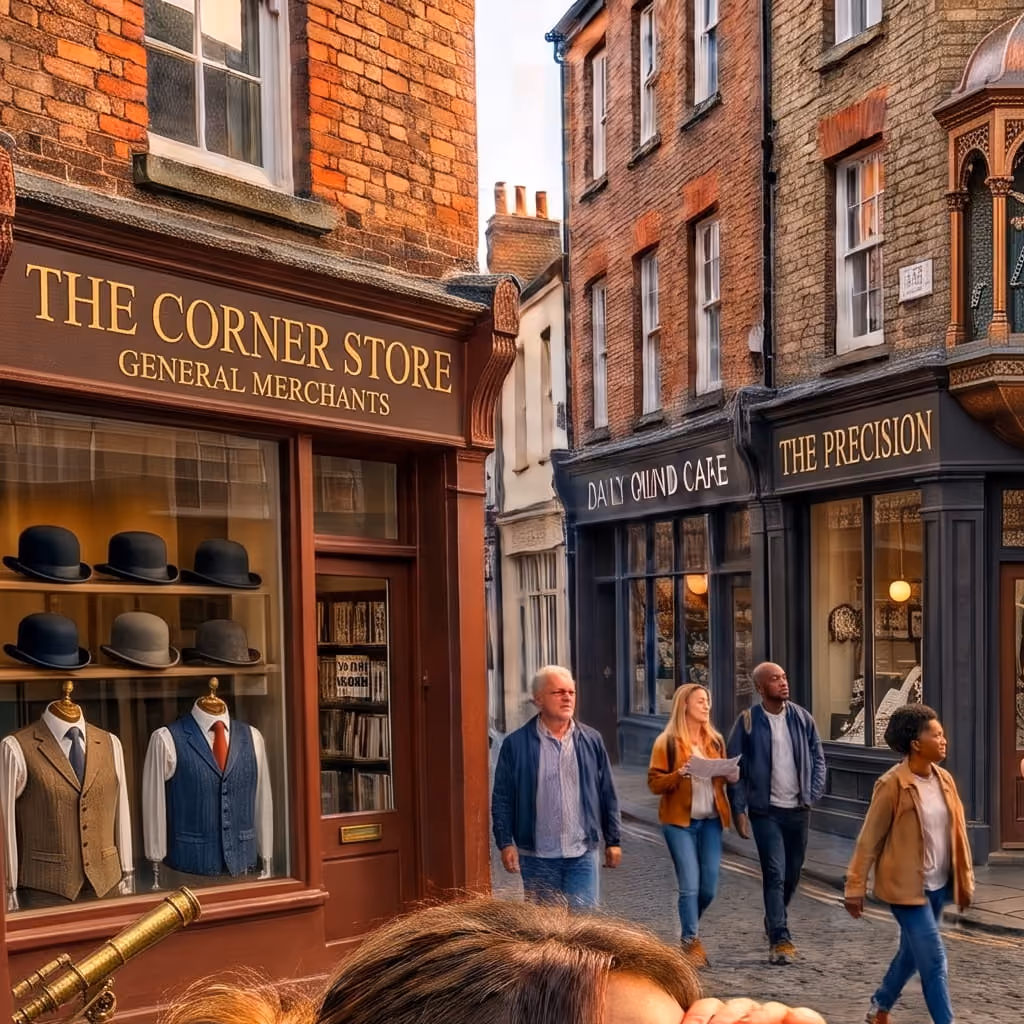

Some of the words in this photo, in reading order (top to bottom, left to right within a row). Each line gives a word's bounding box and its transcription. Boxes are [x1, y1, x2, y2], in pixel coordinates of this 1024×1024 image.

[27, 264, 137, 336] THE
[152, 292, 333, 371] CORNER
[343, 331, 452, 394] STORE
[118, 348, 246, 394] GENERAL
[252, 371, 391, 416] MERCHANTS
[780, 435, 817, 476] THE
[824, 409, 932, 469] PRECISION
